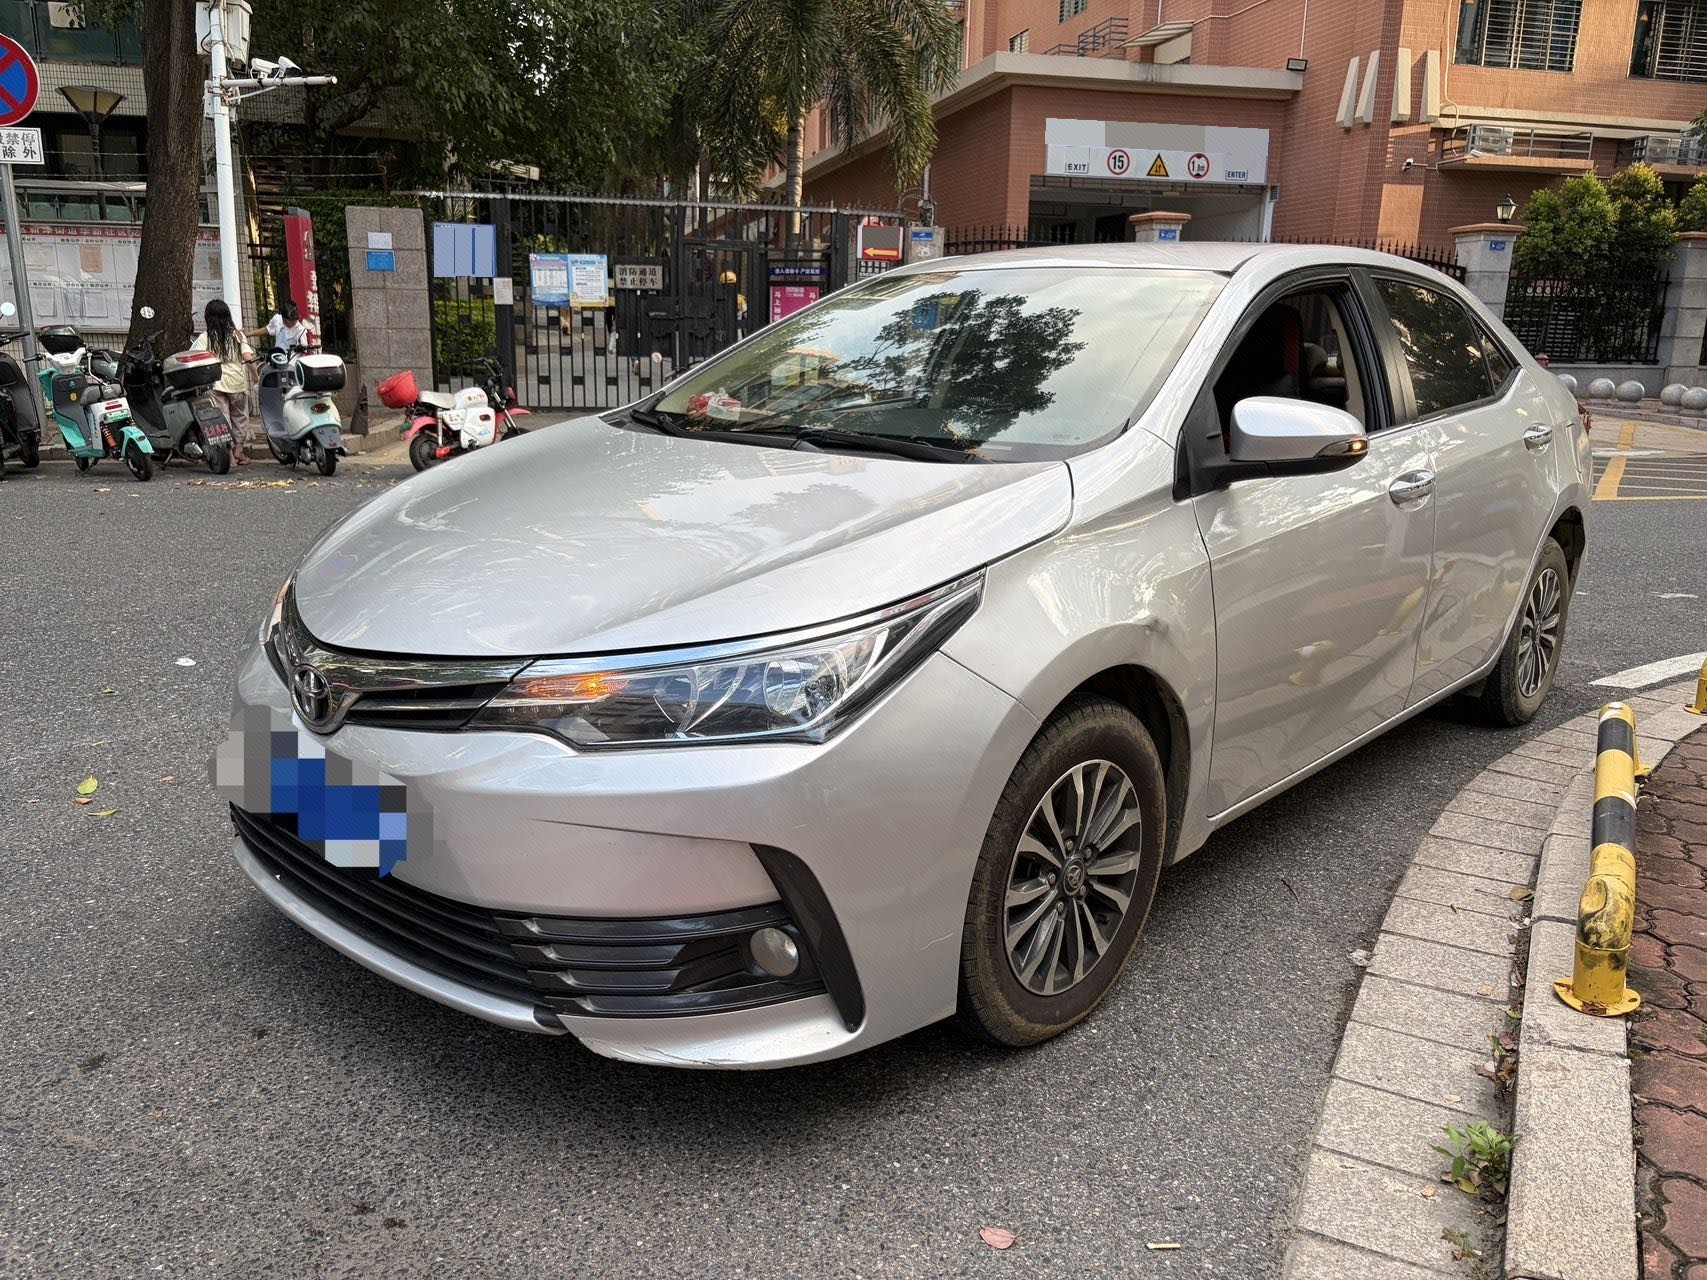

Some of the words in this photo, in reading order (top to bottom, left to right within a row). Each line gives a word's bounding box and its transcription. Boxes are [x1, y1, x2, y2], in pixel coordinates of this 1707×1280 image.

[1067, 163, 1087, 172] EXIT
[1111, 155, 1124, 171] 15
[1227, 171, 1247, 180] ENTER
[619, 267, 657, 277] 消防通道
[619, 276, 658, 287] 禁止停车
